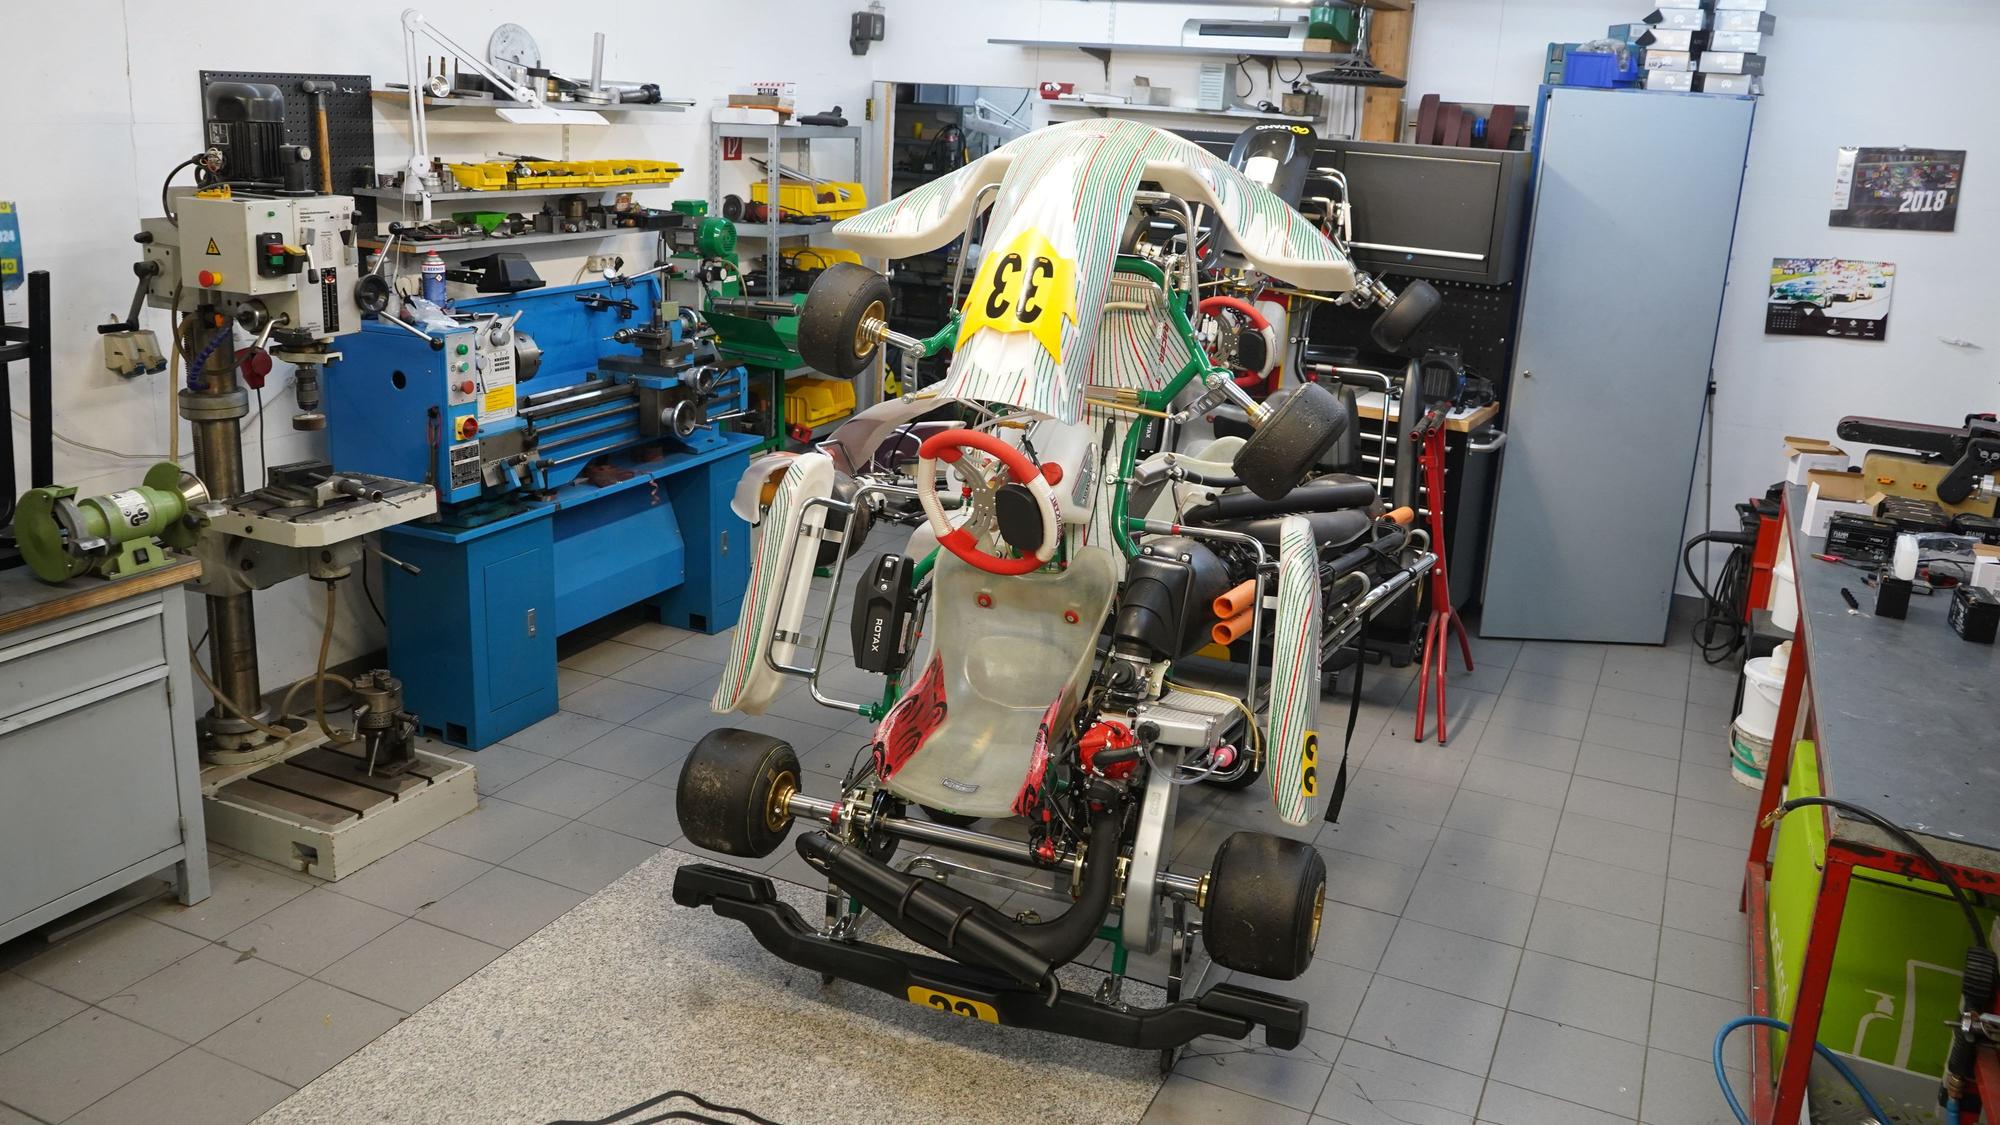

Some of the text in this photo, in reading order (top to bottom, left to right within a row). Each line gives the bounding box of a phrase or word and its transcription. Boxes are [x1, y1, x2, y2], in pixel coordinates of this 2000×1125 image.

[1898, 189, 1948, 213] 2018
[985, 252, 1054, 324] 33
[1159, 322, 1169, 364] RACER
[871, 618, 883, 653] ROTAX
